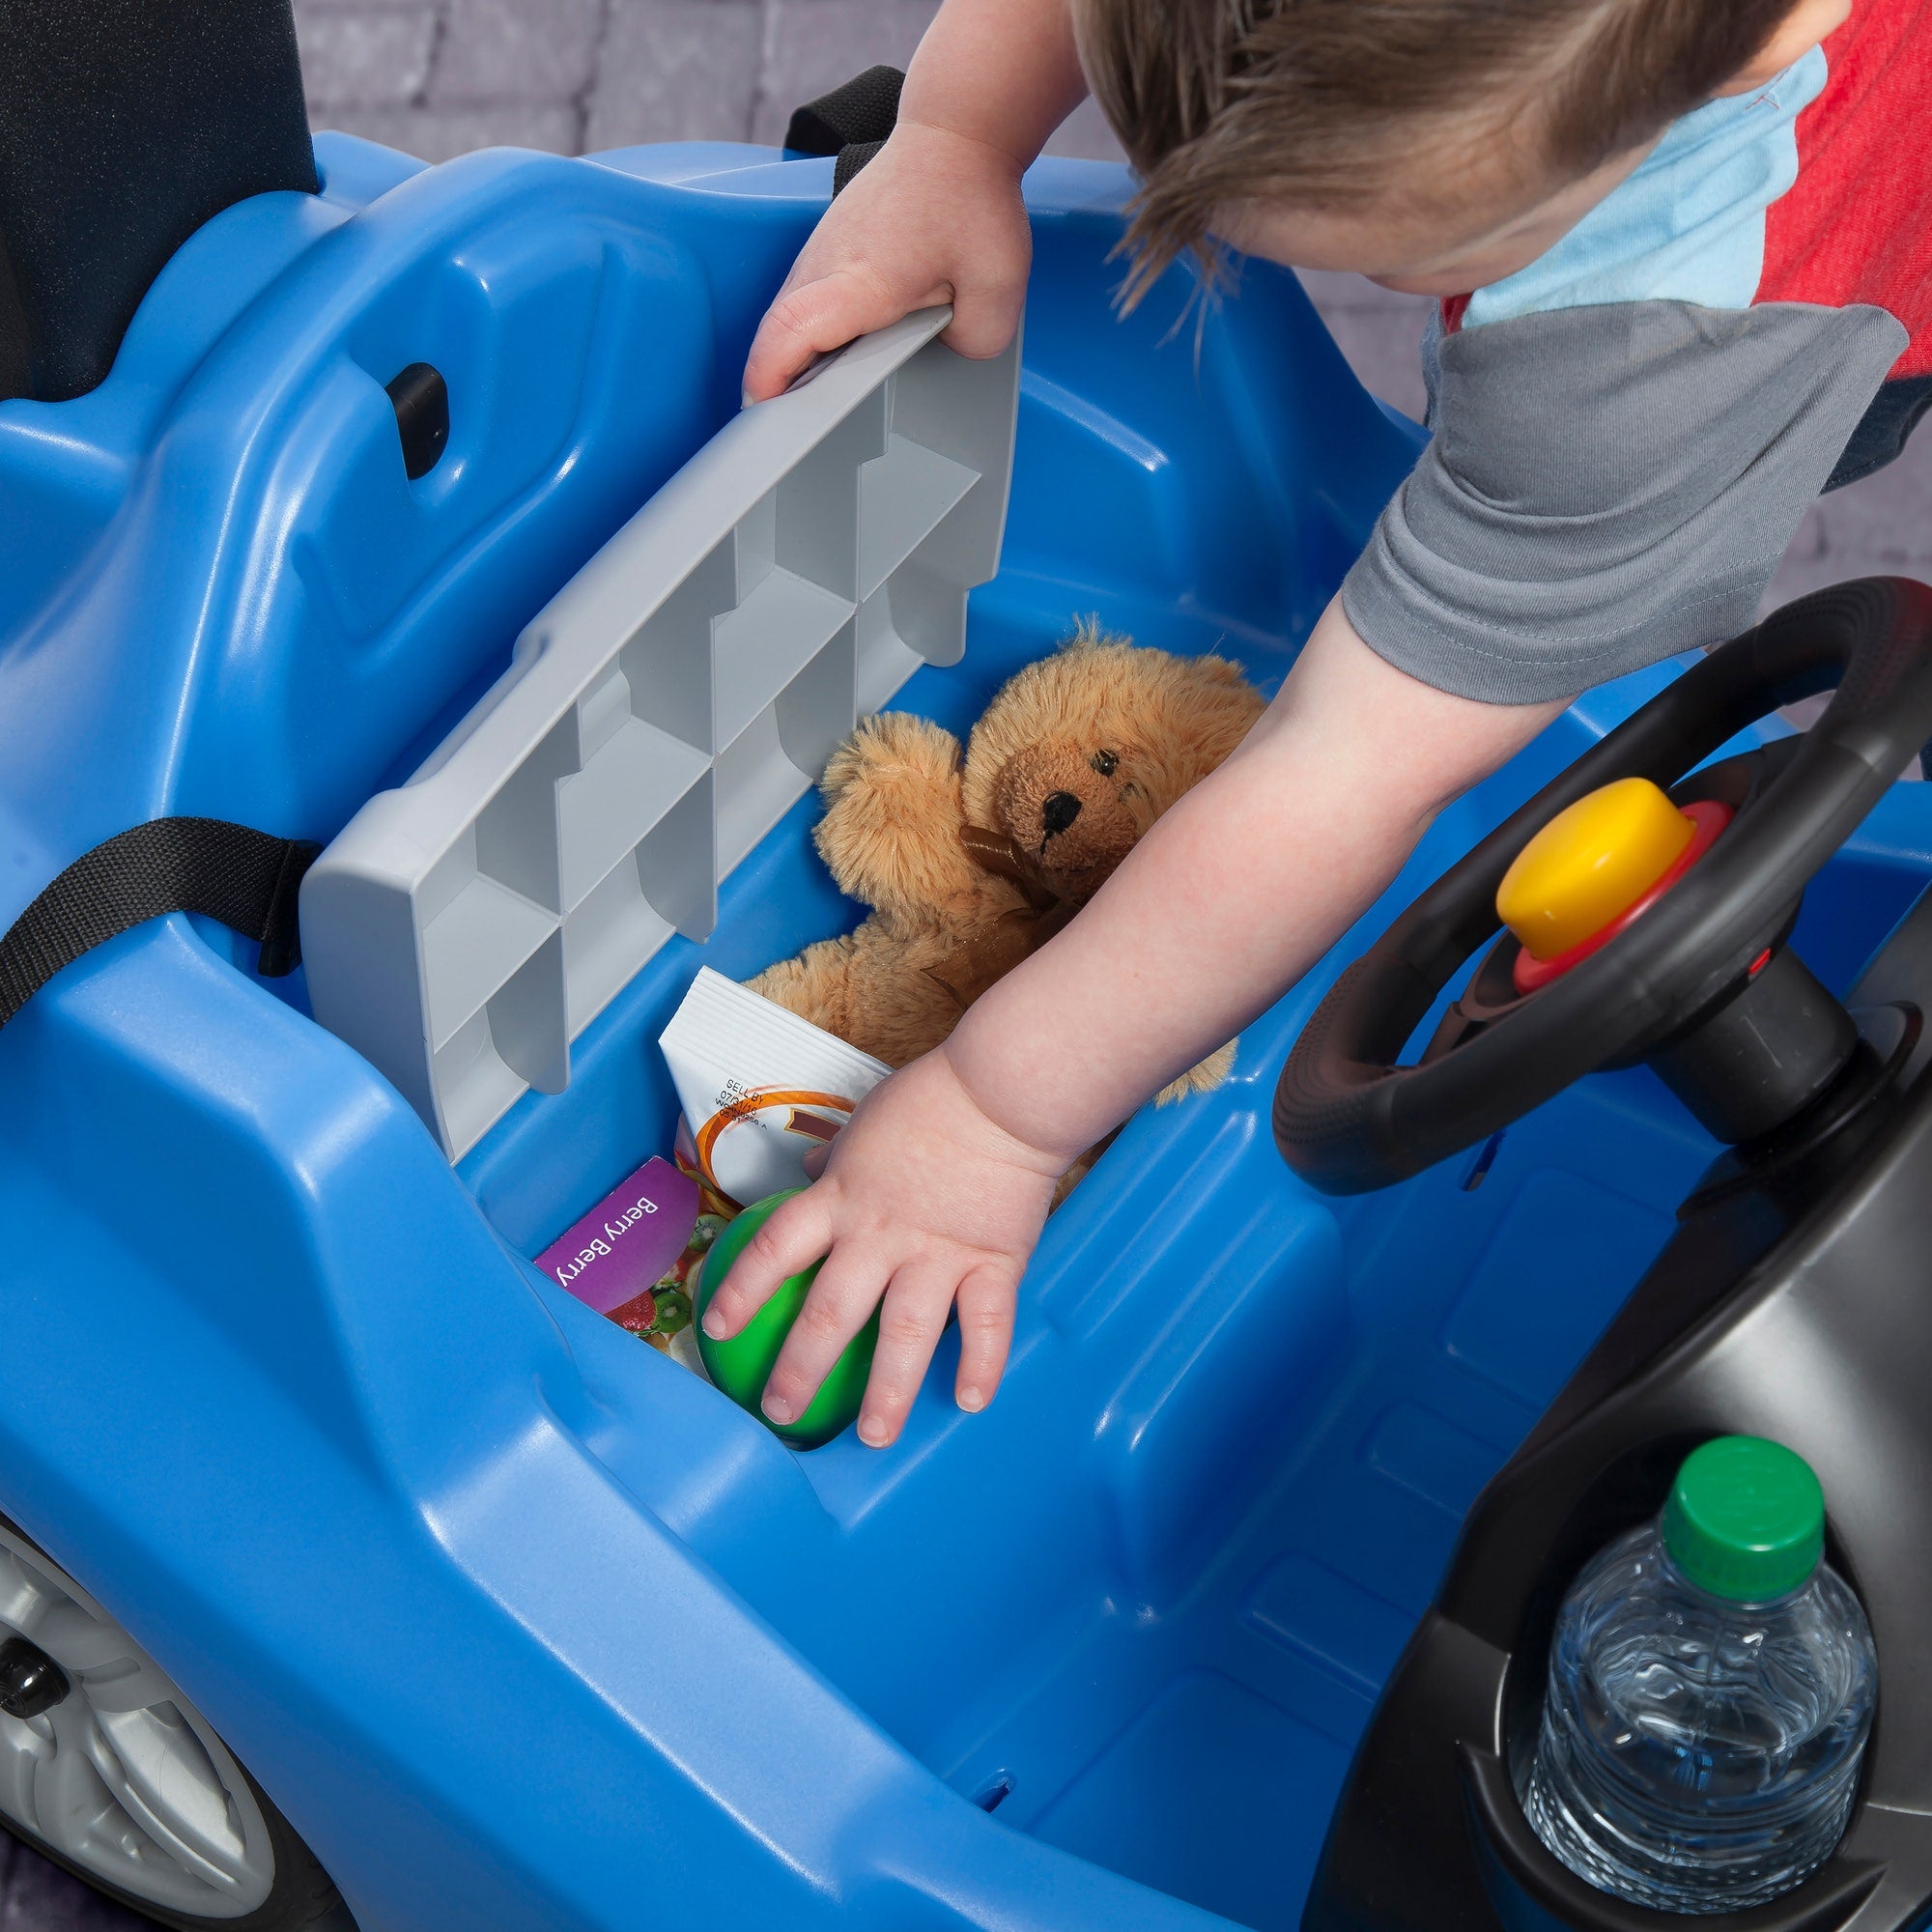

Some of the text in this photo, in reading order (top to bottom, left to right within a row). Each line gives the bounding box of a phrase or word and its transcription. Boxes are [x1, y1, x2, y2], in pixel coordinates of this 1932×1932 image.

[726, 1079, 764, 1105] SELL BY
[555, 1197, 659, 1288] Berry Berry
